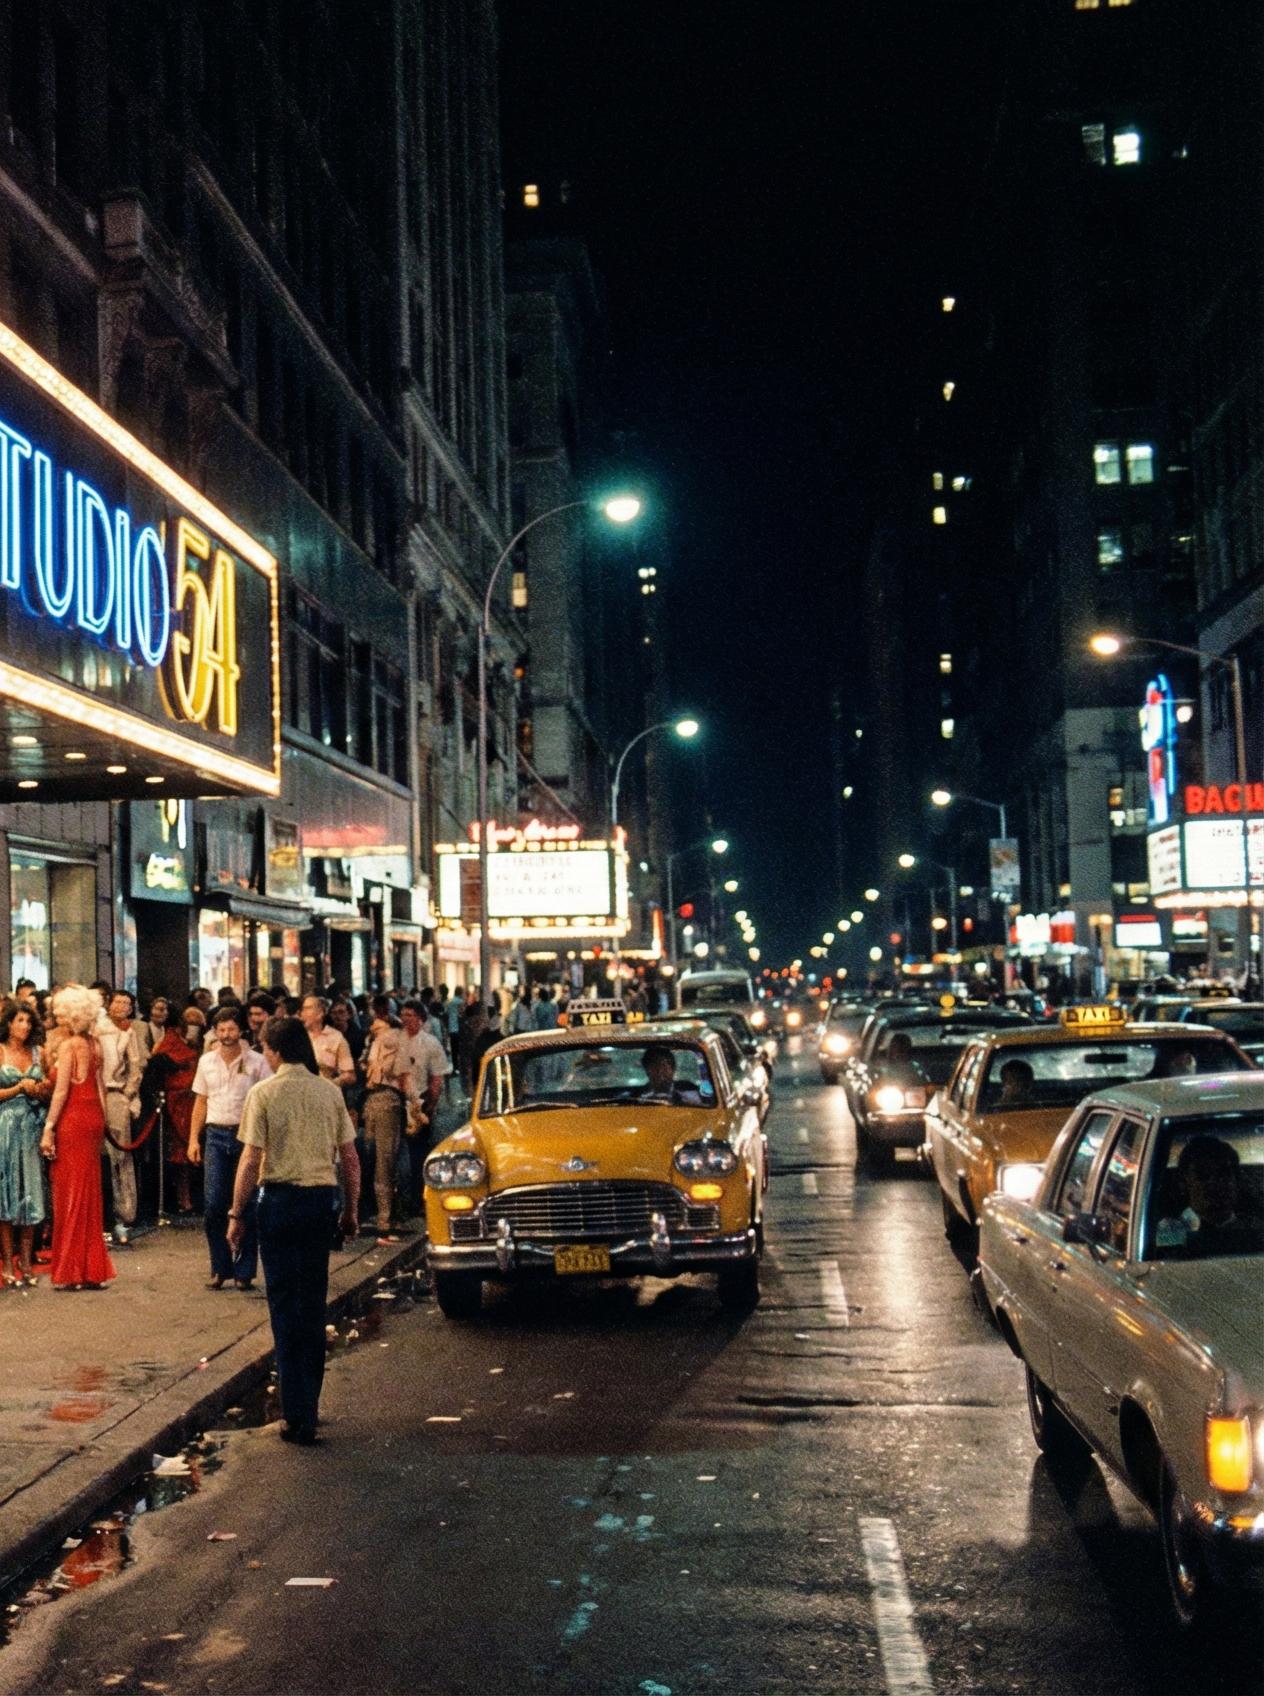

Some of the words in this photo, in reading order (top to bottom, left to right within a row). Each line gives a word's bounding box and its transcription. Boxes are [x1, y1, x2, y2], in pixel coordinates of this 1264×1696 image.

[171, 516, 240, 737] 54
[580, 1012, 612, 1025] TAXI
[1076, 1007, 1111, 1023] TAXI
